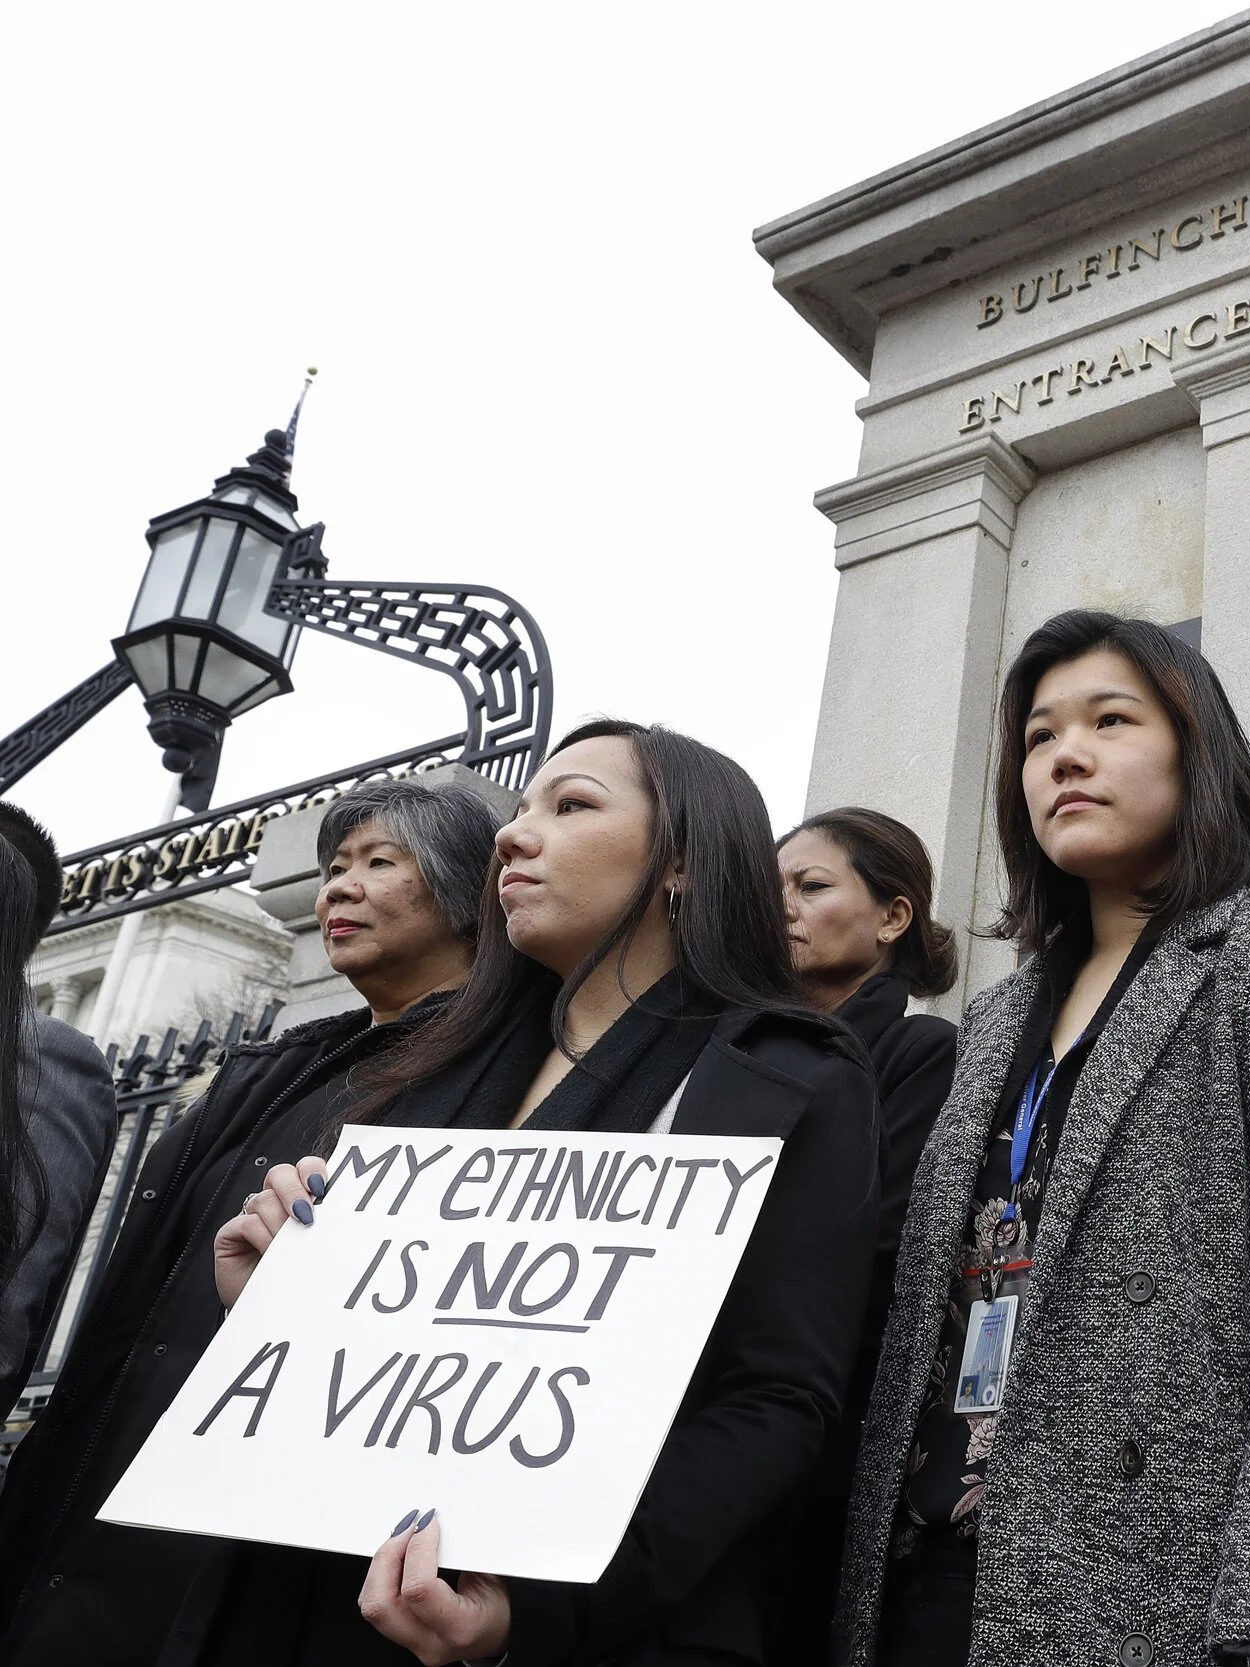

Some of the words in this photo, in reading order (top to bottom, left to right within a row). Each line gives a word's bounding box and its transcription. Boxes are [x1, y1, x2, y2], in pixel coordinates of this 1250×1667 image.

[977, 196, 1248, 329] BULFINCH
[153, 812, 270, 876] STATE
[1018, 1103, 1027, 1130] General
[313, 1145, 453, 1215] MY
[344, 1240, 429, 1313] IS
[435, 1242, 656, 1321] NOT
[193, 1341, 290, 1438] A
[324, 1348, 590, 1468] VIRUS
